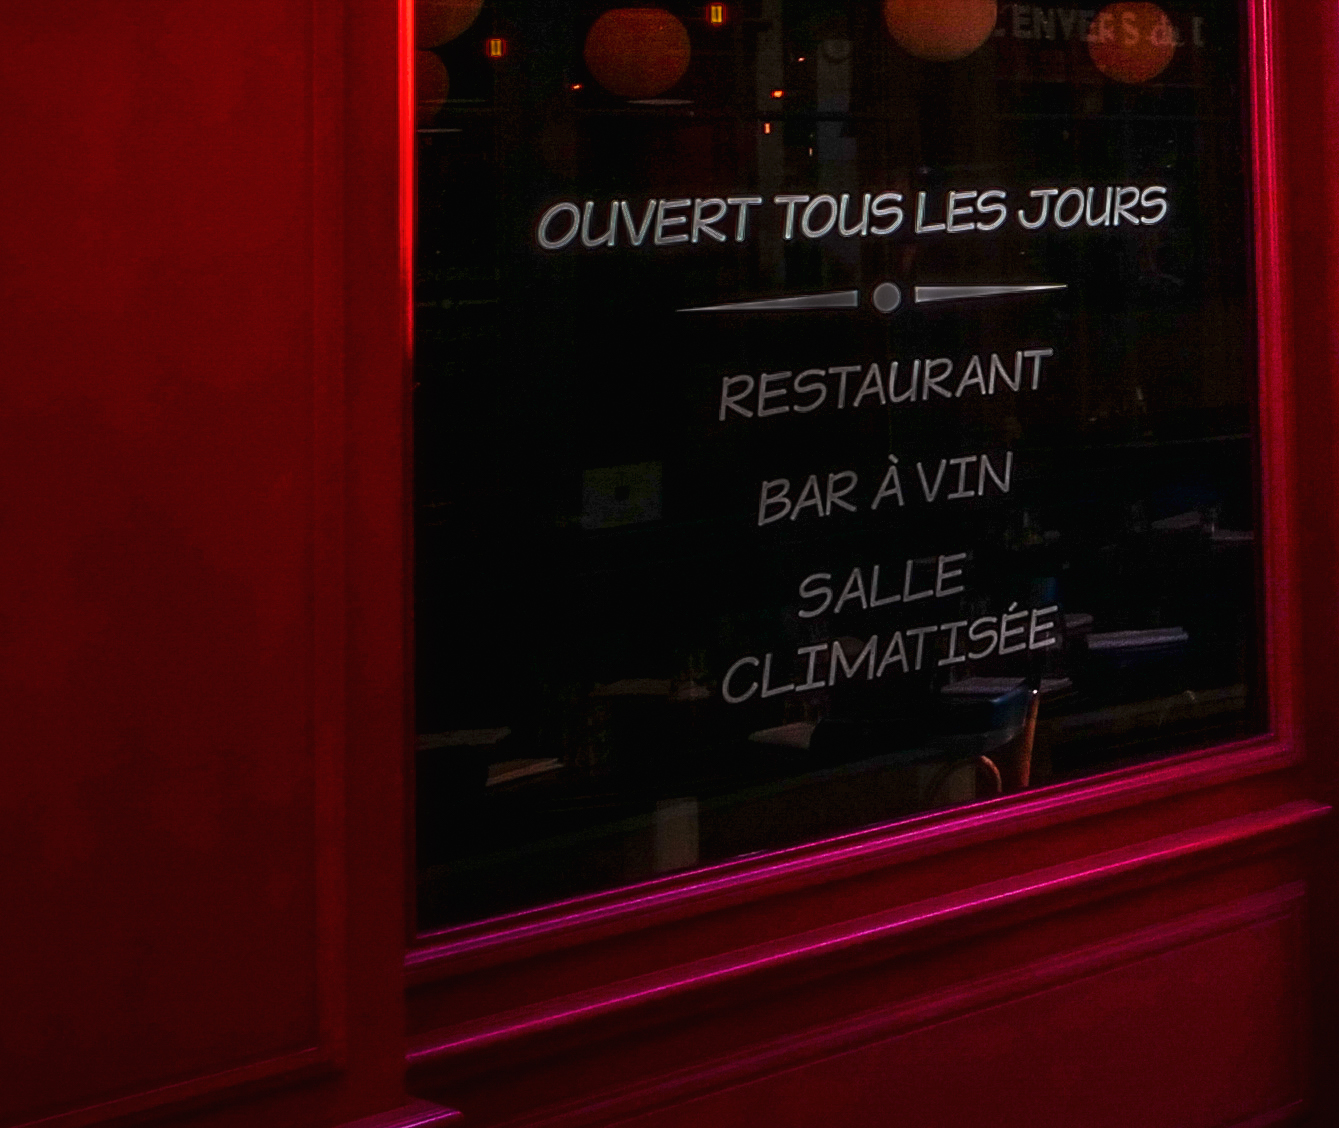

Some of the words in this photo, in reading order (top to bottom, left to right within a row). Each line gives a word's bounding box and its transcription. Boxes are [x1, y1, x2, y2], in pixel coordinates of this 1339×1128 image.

[537, 197, 763, 249] OUVERT
[775, 192, 904, 241] TOUS
[915, 189, 1008, 234] LES
[1017, 185, 1169, 231] JOURS
[718, 347, 1054, 421] RESTAURANT
[757, 469, 858, 527] BAR
[871, 453, 904, 511] À
[916, 450, 1013, 505] VIN
[798, 552, 967, 619] SALLE
[721, 602, 1059, 705] CLIMATISÉE
